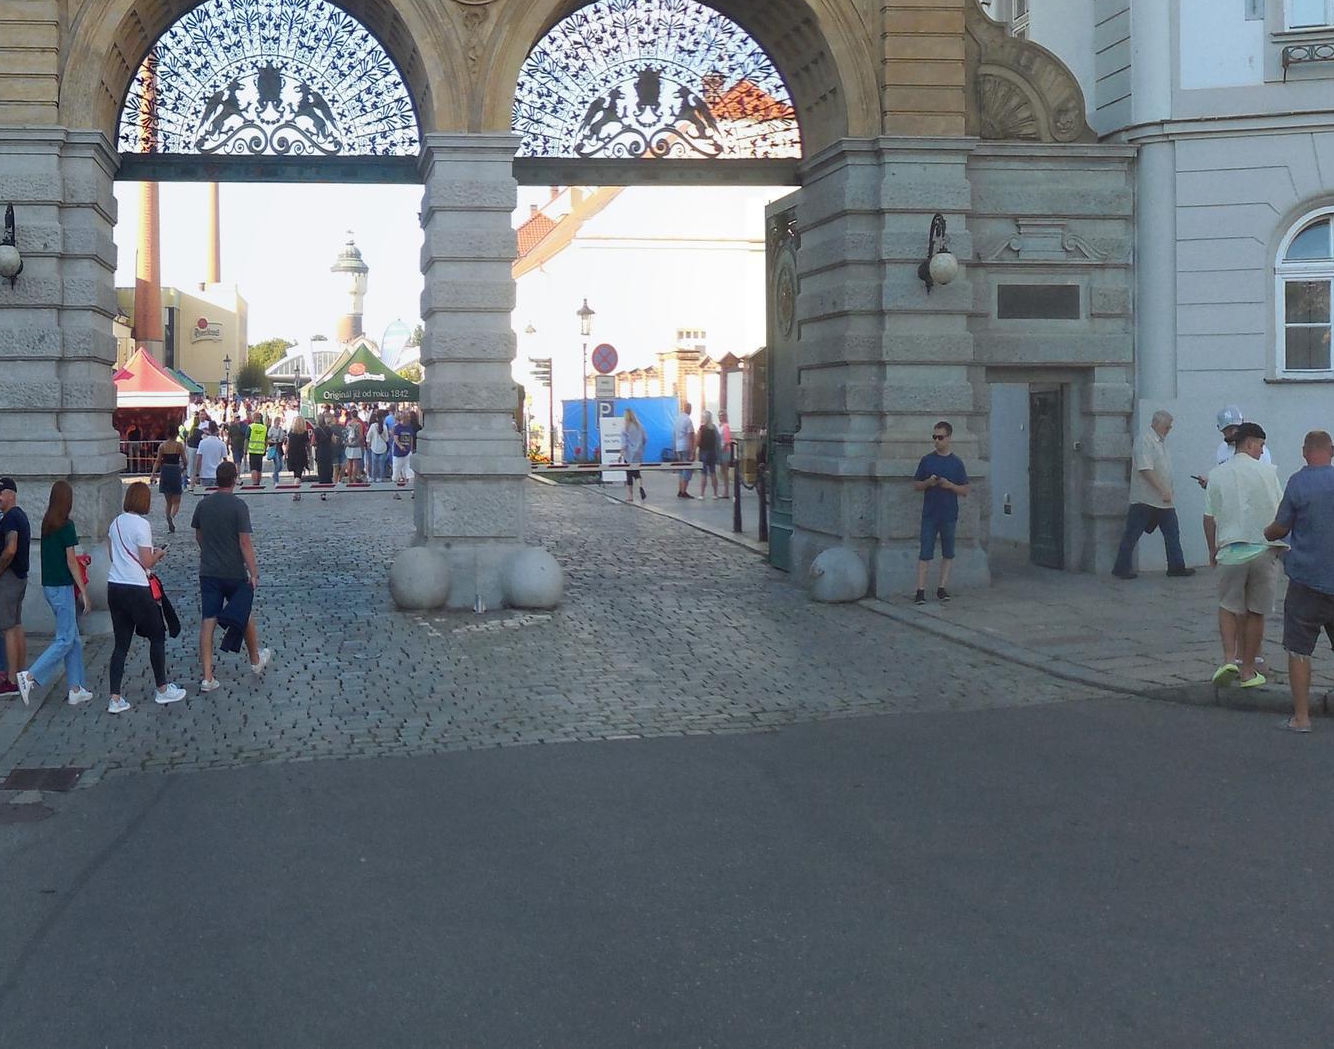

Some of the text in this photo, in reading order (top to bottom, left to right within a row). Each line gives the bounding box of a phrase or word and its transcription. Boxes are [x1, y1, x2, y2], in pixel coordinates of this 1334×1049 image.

[323, 390, 352, 400] Originál
[362, 390, 371, 398] od
[373, 389, 389, 398] roku
[391, 389, 409, 398] 1842
